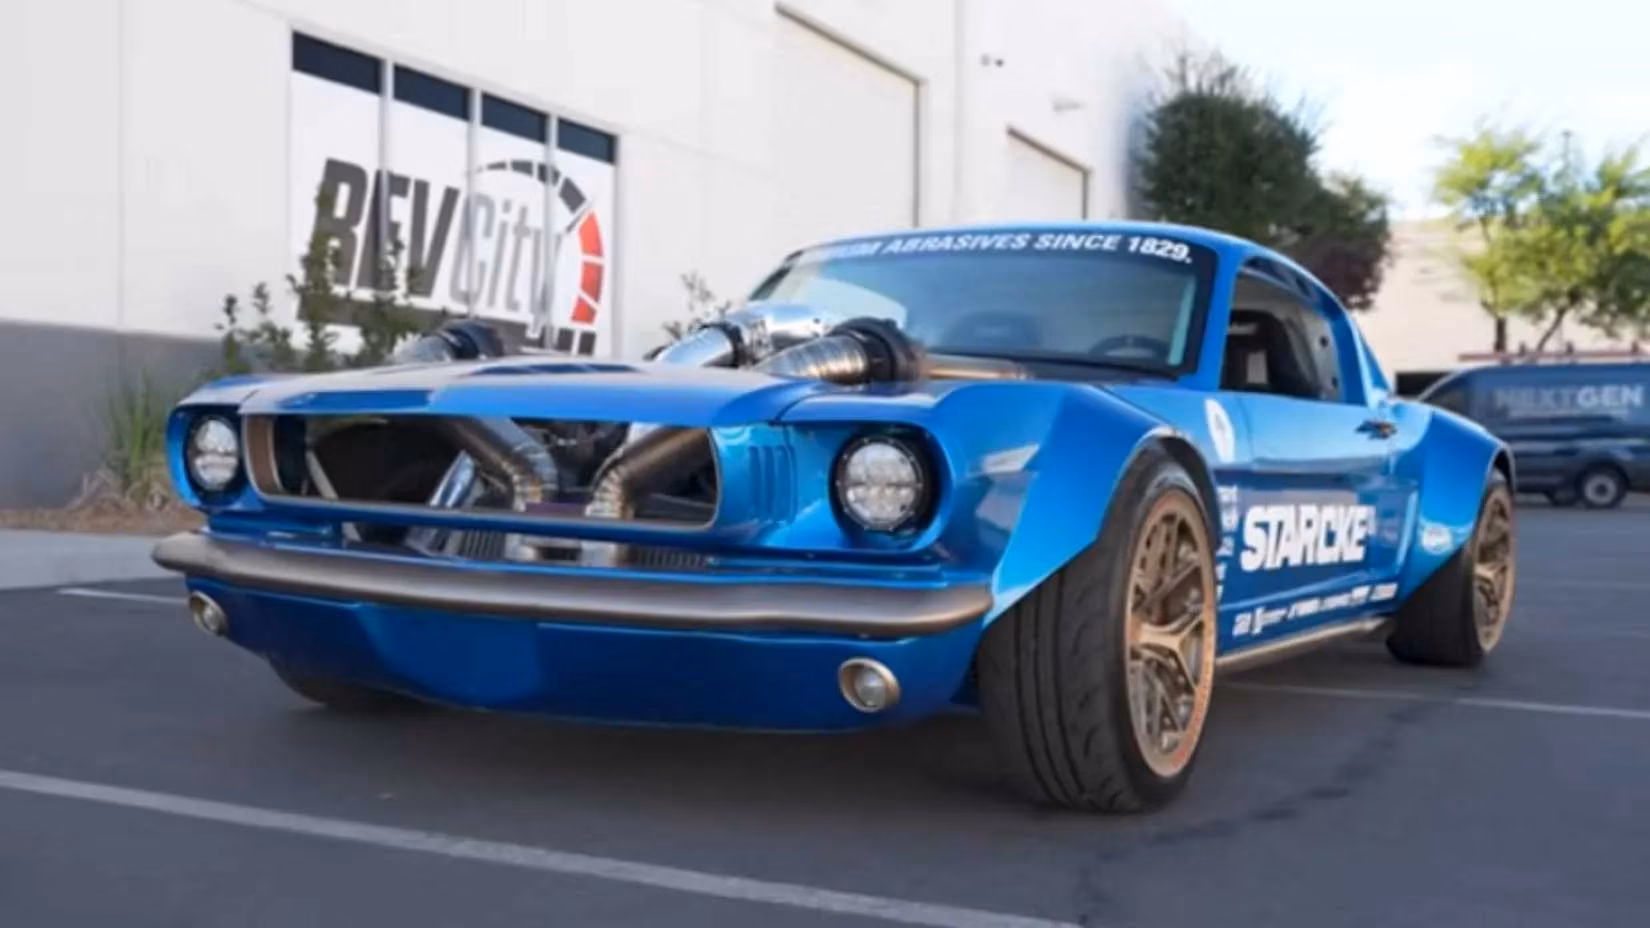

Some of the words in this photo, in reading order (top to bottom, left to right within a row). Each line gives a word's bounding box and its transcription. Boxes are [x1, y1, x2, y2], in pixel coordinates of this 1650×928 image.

[882, 233, 1029, 255] ABRASIVES
[1035, 234, 1121, 250] SINCE
[1128, 236, 1193, 264] 1829.
[1240, 504, 1375, 572] STARCKE
